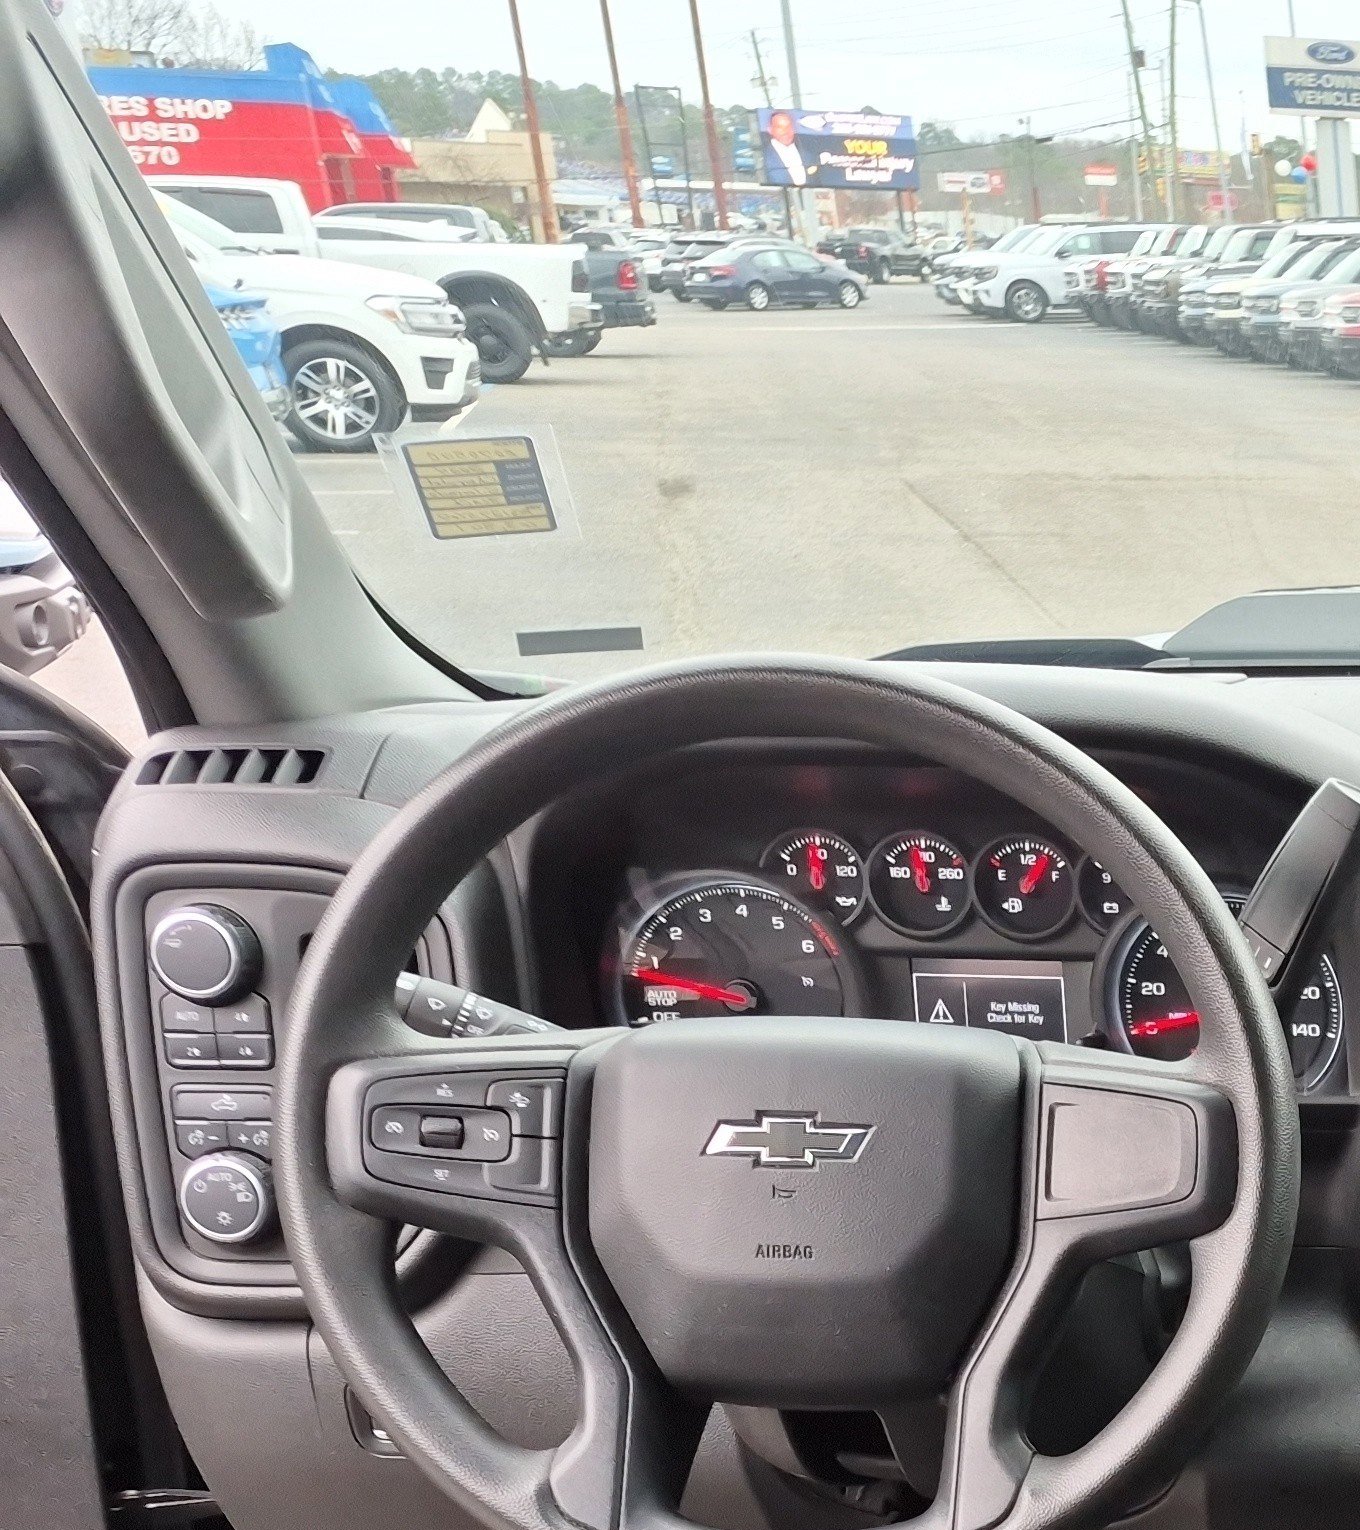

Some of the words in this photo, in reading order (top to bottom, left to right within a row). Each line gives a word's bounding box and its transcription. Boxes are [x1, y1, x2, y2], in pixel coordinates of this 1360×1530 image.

[154, 97, 233, 119] SHOP
[117, 121, 200, 142] USED
[844, 139, 888, 156] YOUR
[786, 863, 797, 876] 0
[835, 865, 857, 878] 120
[889, 866, 911, 879] 160
[938, 868, 964, 880] 260
[997, 869, 1007, 881] E
[1051, 870, 1060, 882] F
[698, 908, 712, 923] 3
[735, 904, 748, 917] 4
[771, 915, 785, 930] 5
[668, 926, 683, 941] 2
[801, 939, 815, 953] 6
[646, 990, 677, 999] AUTO
[1141, 982, 1165, 996] 20
[647, 998, 677, 1006] STOP
[990, 1001, 1007, 1013] Key
[1008, 1002, 1040, 1014] Missing
[652, 1011, 680, 1022] OFF
[987, 1012, 1012, 1023] Check
[1013, 1013, 1026, 1024] for
[1028, 1013, 1044, 1025] Key
[1291, 1023, 1320, 1037] 140
[206, 1172, 233, 1182] AUTO
[754, 1243, 814, 1260] AIRBAG
